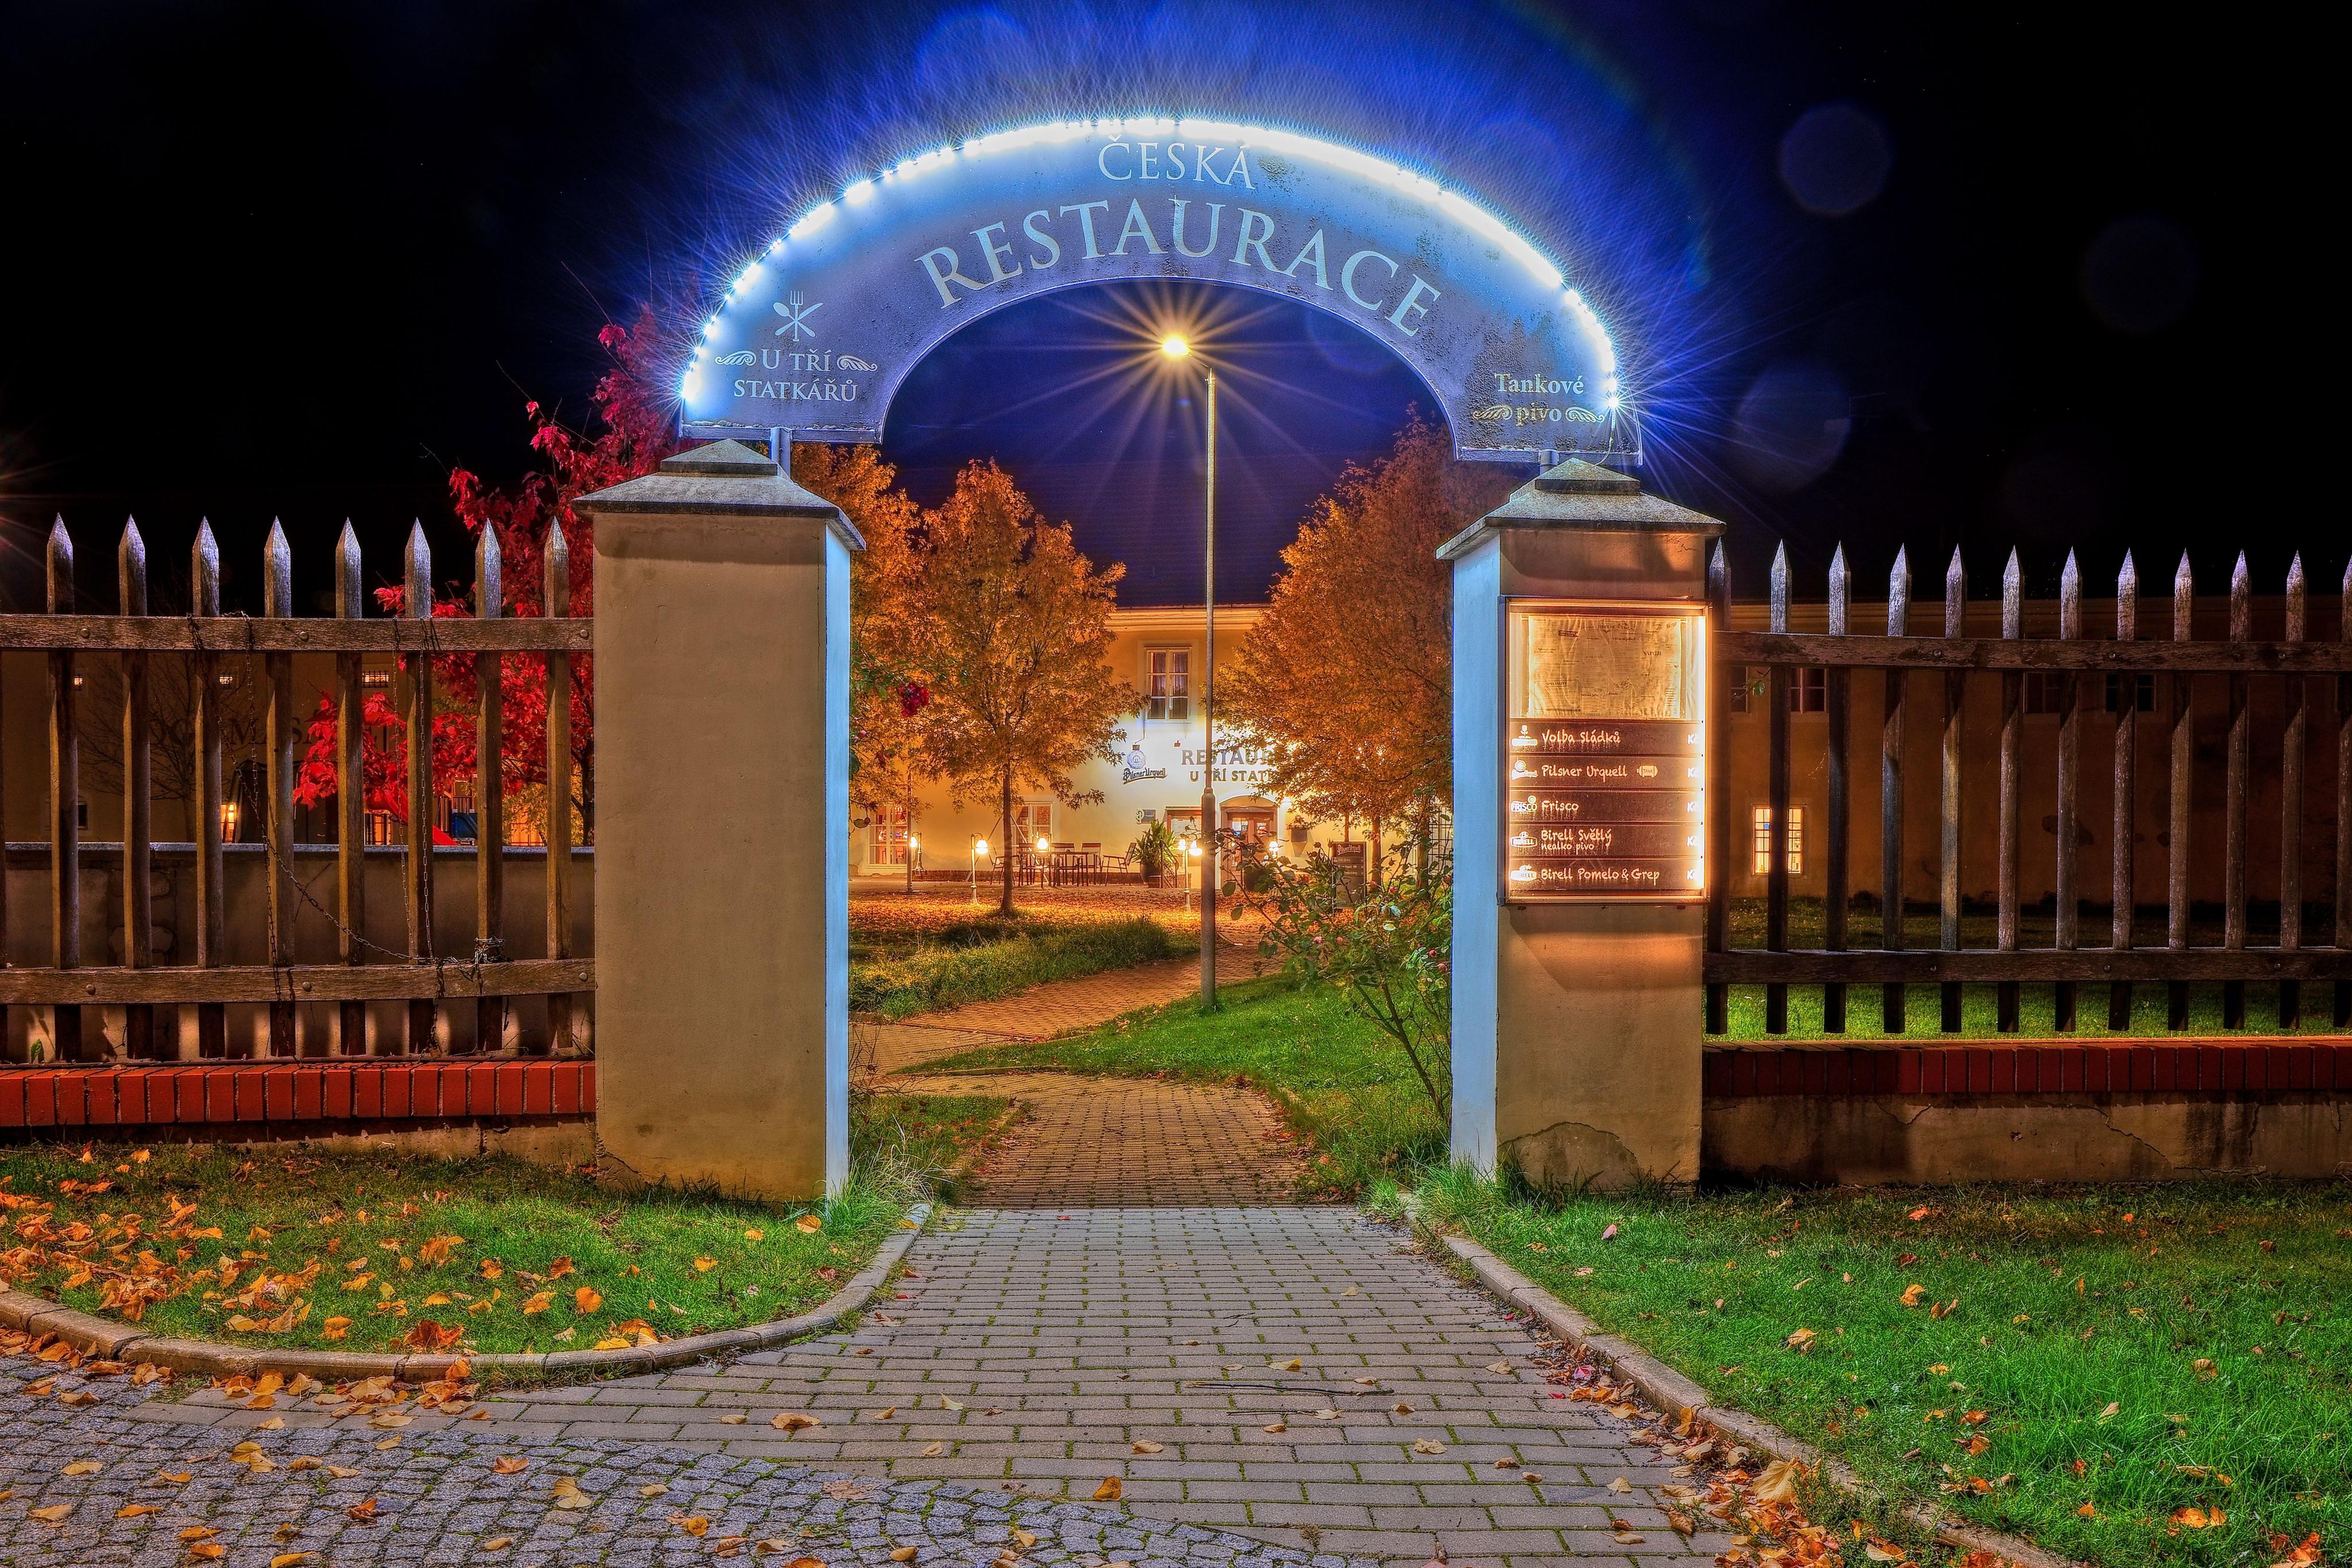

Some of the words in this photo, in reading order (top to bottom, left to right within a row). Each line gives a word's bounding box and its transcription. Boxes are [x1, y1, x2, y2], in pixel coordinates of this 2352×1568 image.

[1098, 134, 1255, 189] ČESKÁ
[914, 196, 1442, 336] RESTAURACE
[760, 349, 782, 369] U
[789, 349, 832, 372] TŘÍ
[734, 378, 858, 401] STATKÁŘŮ
[1495, 373, 1584, 394] Tankové
[1516, 402, 1562, 426] pivo
[1542, 729, 1575, 744] Volba
[1580, 729, 1621, 744] Sládků
[1123, 768, 1145, 782] Pilsner
[1145, 766, 1166, 779] Urquell
[1190, 771, 1199, 782] U
[1542, 765, 1583, 777] Pilsner
[1586, 765, 1628, 783] Urquell
[1542, 800, 1580, 811] Frisco
[1541, 828, 1575, 841] Birell
[1578, 828, 1612, 847] Světlý
[1541, 842, 1573, 850] nealko
[1576, 842, 1595, 855] pivo
[1541, 868, 1573, 880] Birell
[1577, 868, 1619, 880] Pomelo
[1631, 868, 1660, 886] Grep
